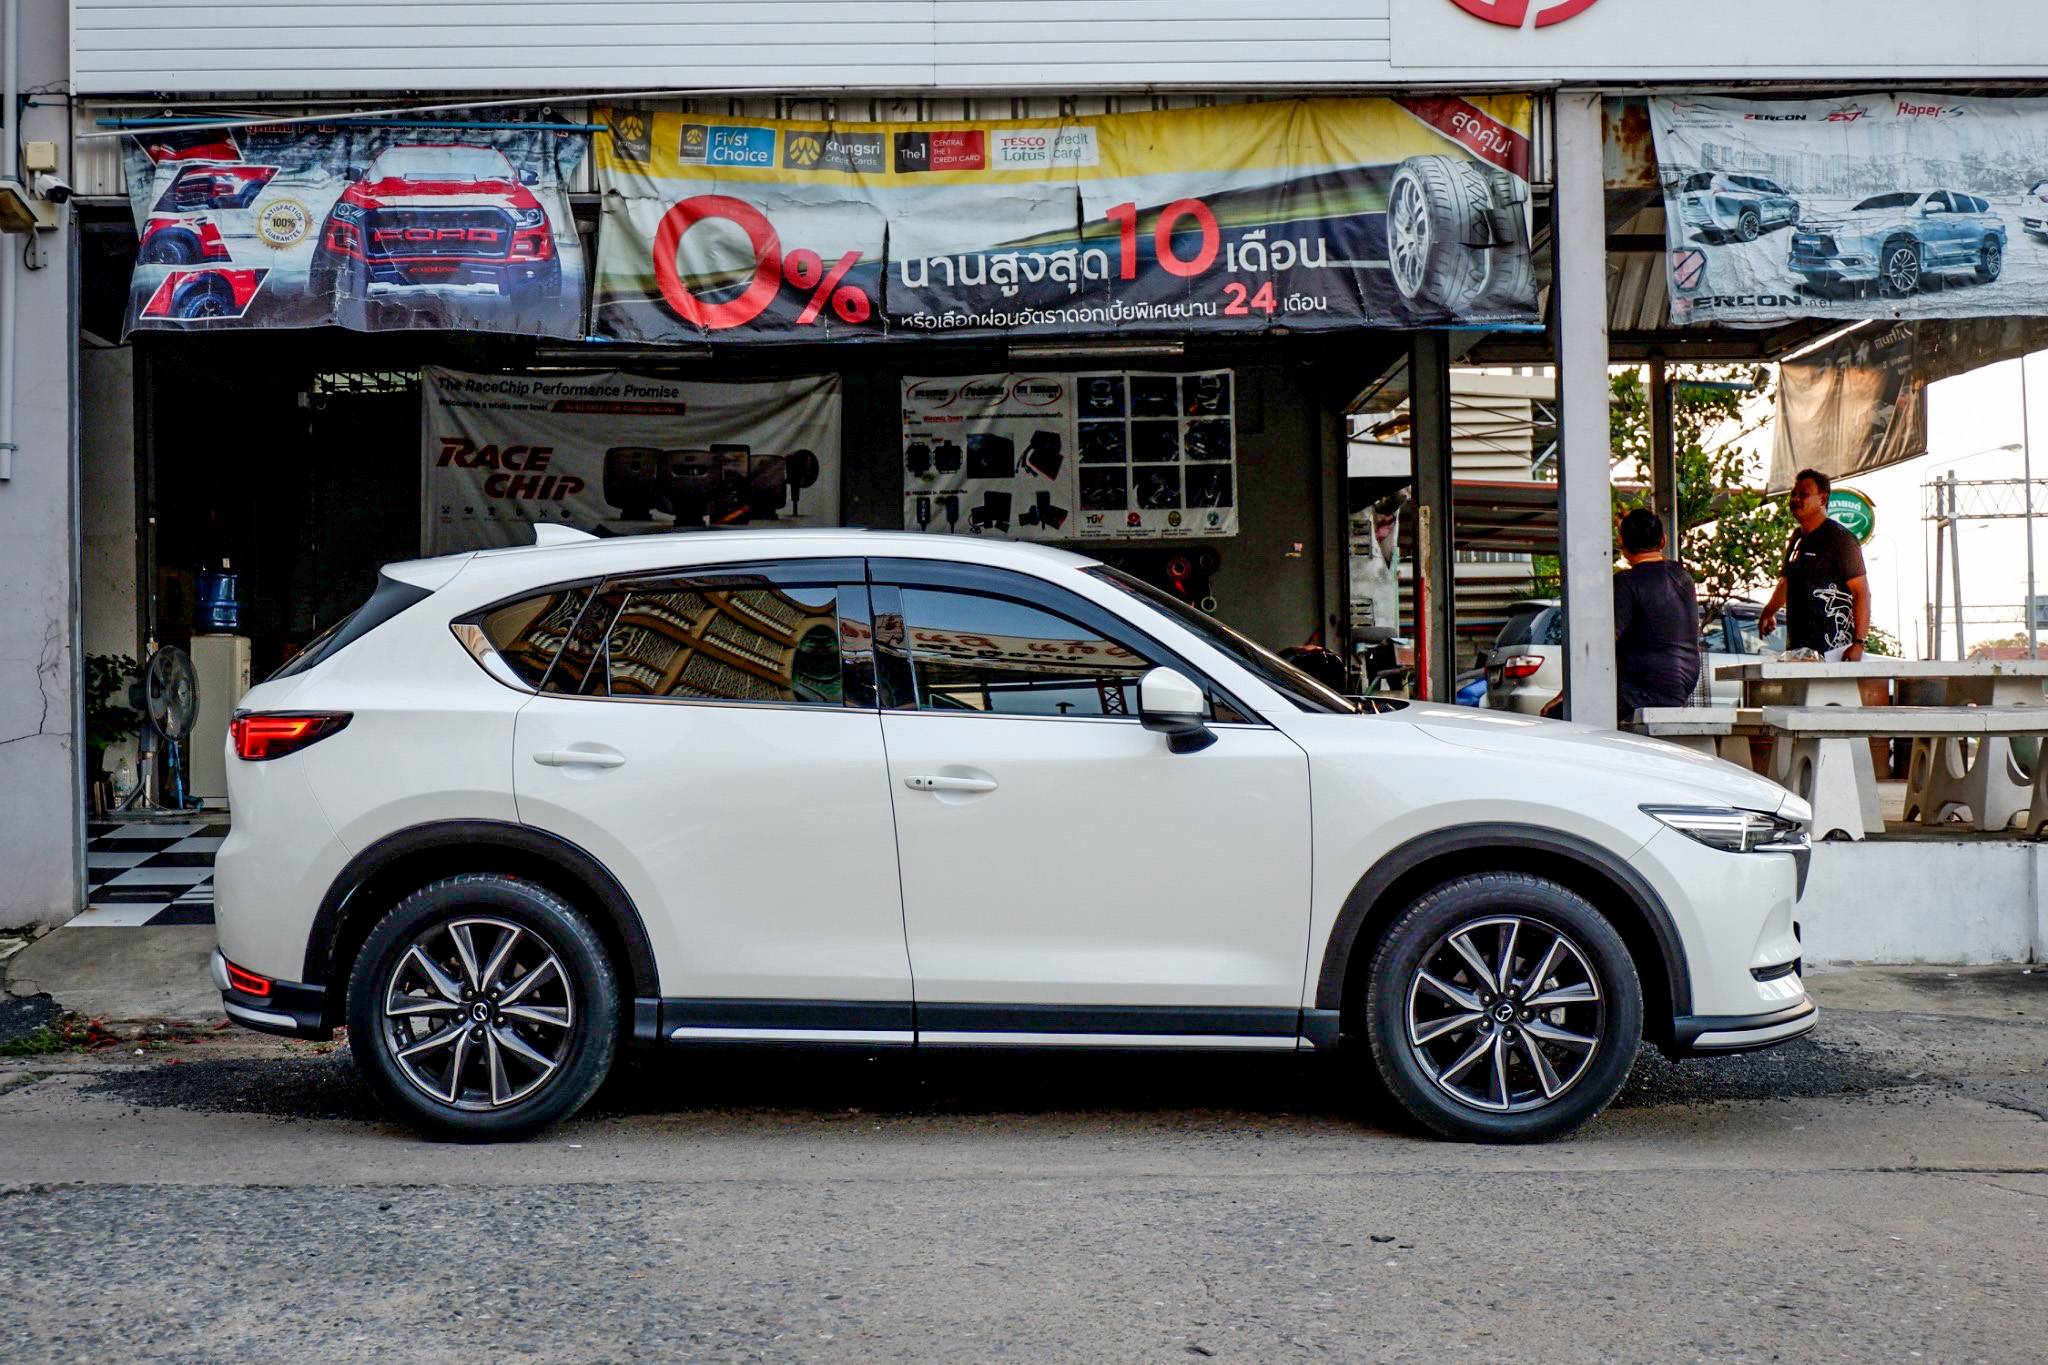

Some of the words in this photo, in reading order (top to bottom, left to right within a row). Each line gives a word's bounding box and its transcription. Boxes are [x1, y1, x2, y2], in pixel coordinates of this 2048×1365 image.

[1744, 113, 1807, 121] ZERCON
[1054, 132, 1089, 146] credit
[1452, 111, 1512, 157] สุดคุ้ม!
[932, 139, 963, 147] CENTRAL
[1000, 136, 1046, 147] TESCO
[713, 146, 768, 162] Choice
[933, 147, 946, 155] THE
[1003, 150, 1046, 161] Lotus
[1053, 147, 1082, 159] card
[824, 154, 849, 165] Credit
[851, 156, 877, 166] Cards
[933, 155, 958, 164] CREDIT
[959, 153, 980, 162] CARD
[264, 204, 304, 222] SATISFACTION
[272, 217, 296, 228] 100%
[265, 227, 302, 242] GUARANTEE
[374, 228, 498, 242] FORD
[900, 246, 1109, 298] นานสูงสุด
[1105, 198, 1221, 280] 10
[1226, 228, 1327, 273] เดือน
[653, 194, 872, 330] 0%
[1223, 281, 1277, 316] 24
[1283, 292, 1327, 312] เดือน
[438, 377, 462, 391] The
[465, 379, 529, 397] RaceChip
[532, 381, 620, 398] Performance
[623, 384, 680, 399] Promise
[436, 437, 554, 472] RACE
[484, 473, 585, 501] CHIP
